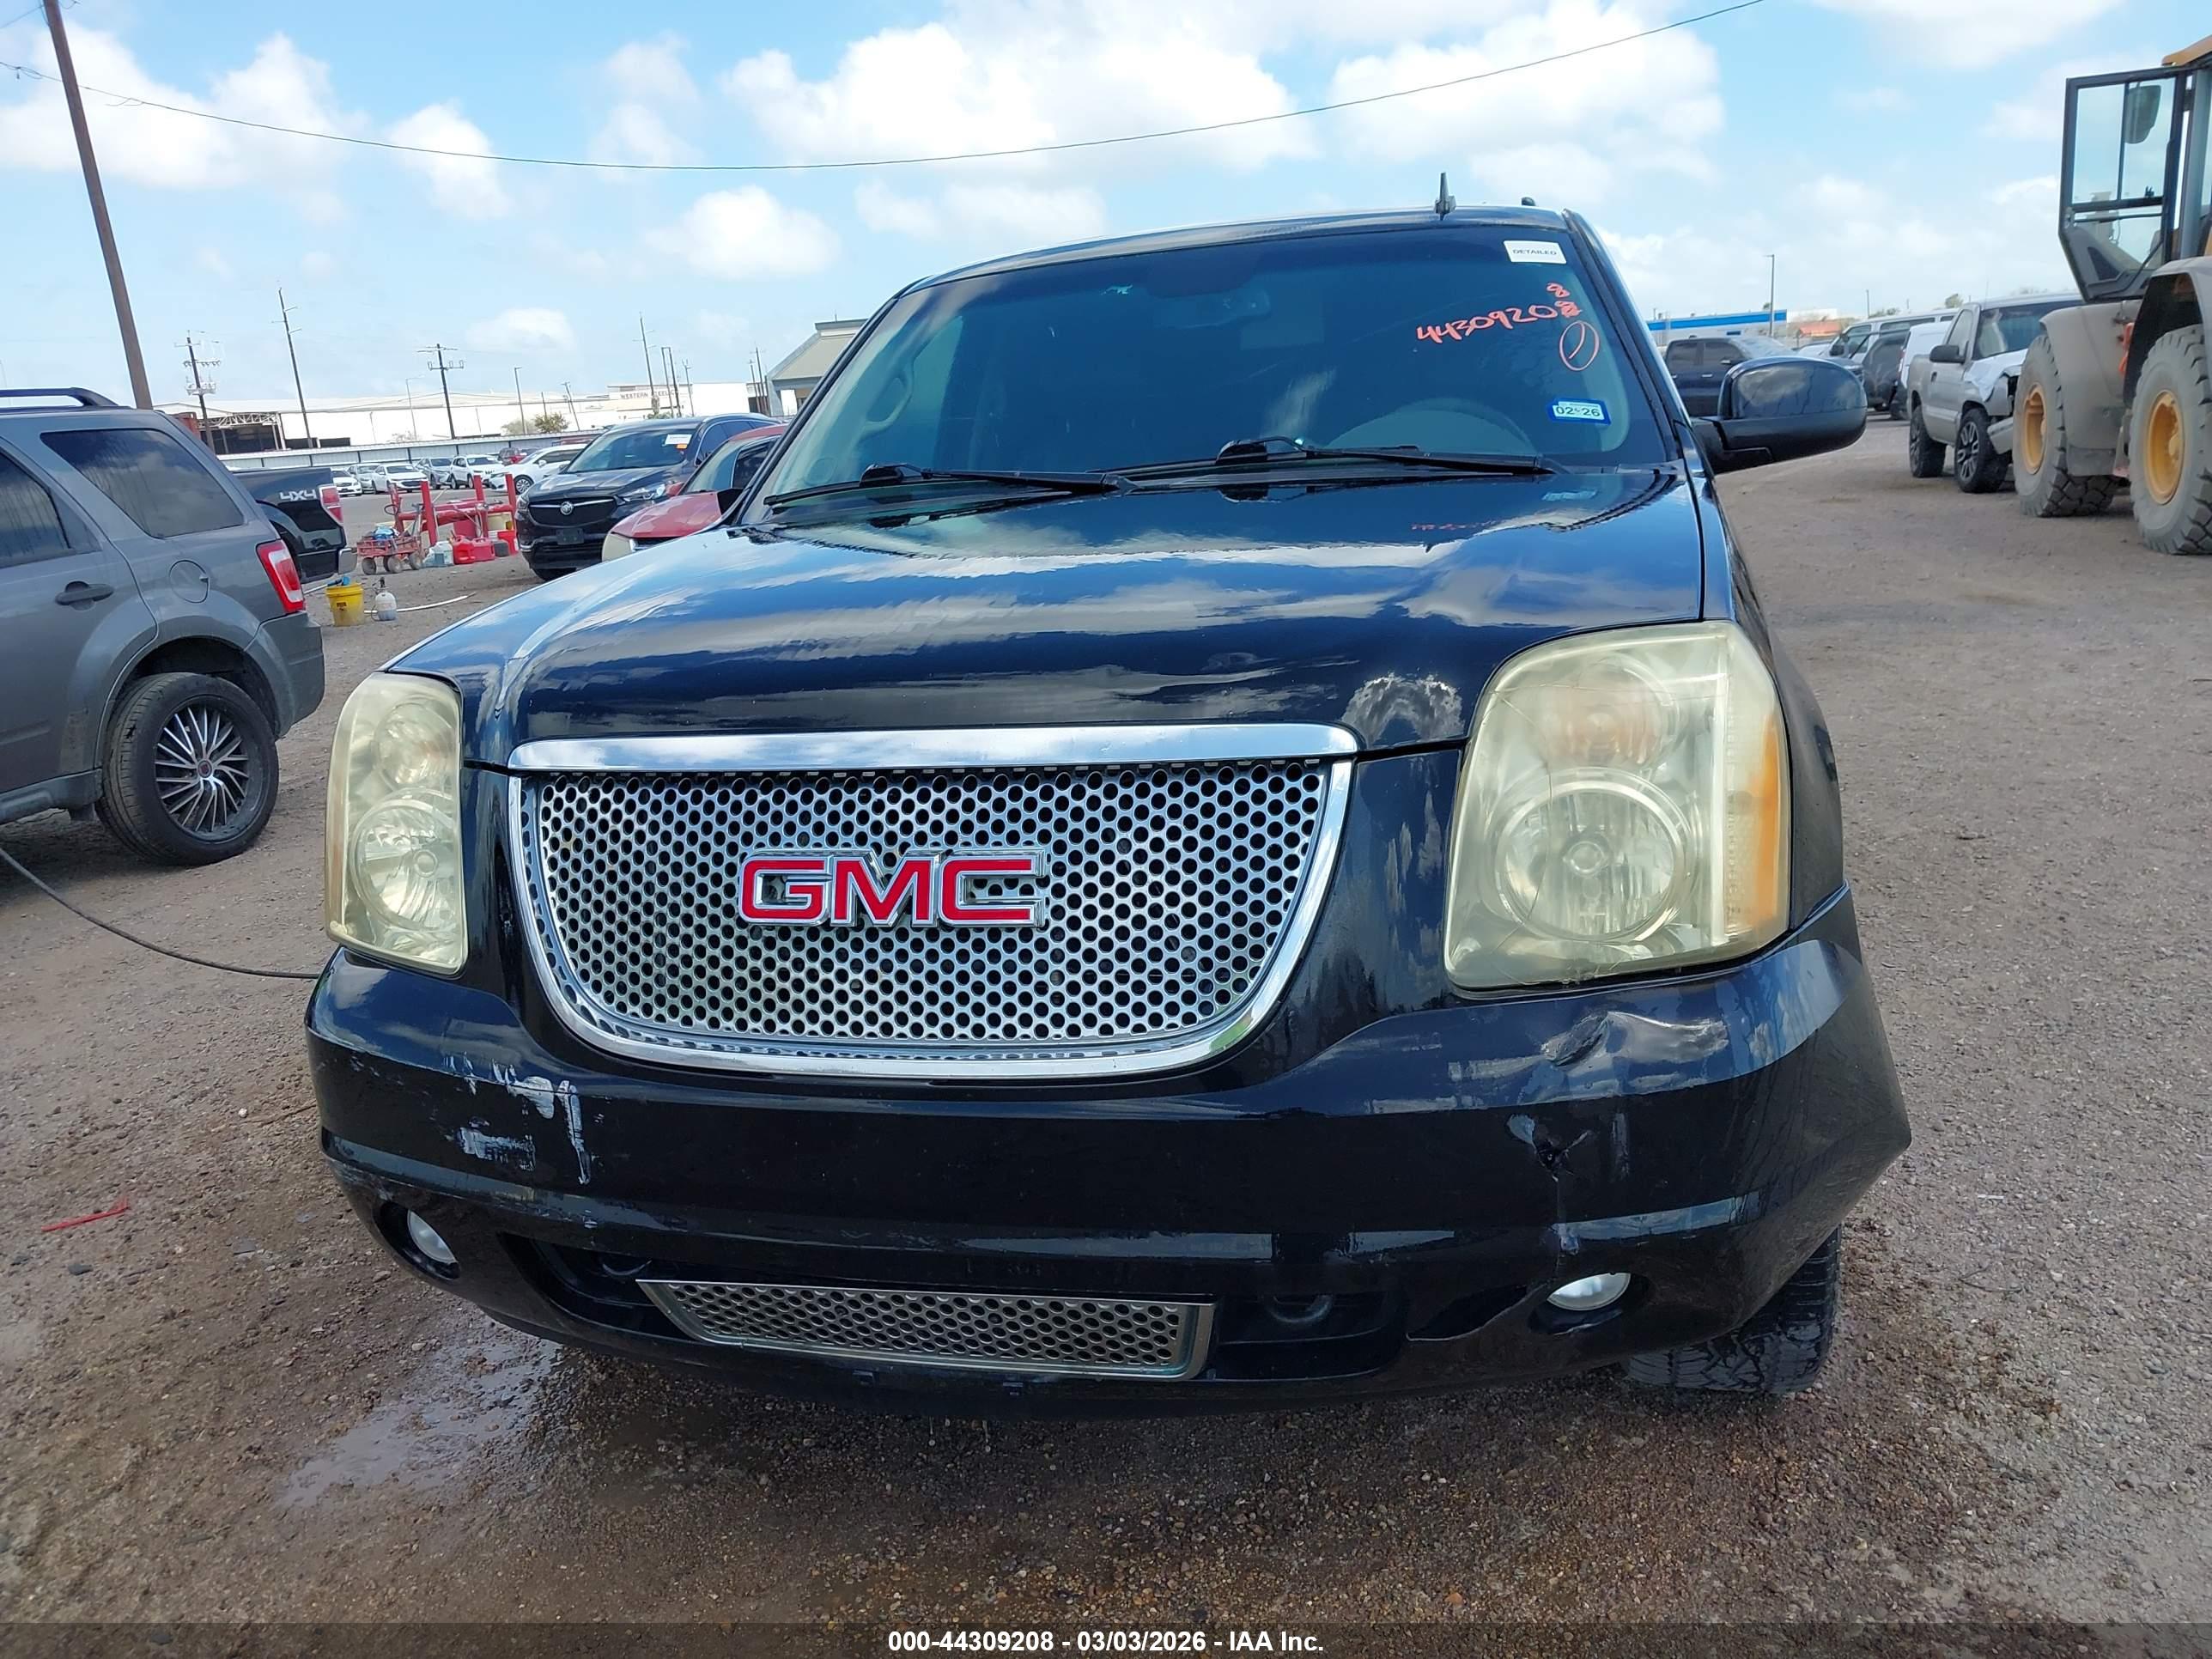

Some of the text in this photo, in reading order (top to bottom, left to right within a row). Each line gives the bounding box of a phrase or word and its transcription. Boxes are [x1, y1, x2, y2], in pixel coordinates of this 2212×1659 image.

[1555, 405, 1575, 416] 02
[1581, 407, 1601, 417] 26
[279, 489, 318, 501] 4X4
[739, 848, 1047, 928] GMC
